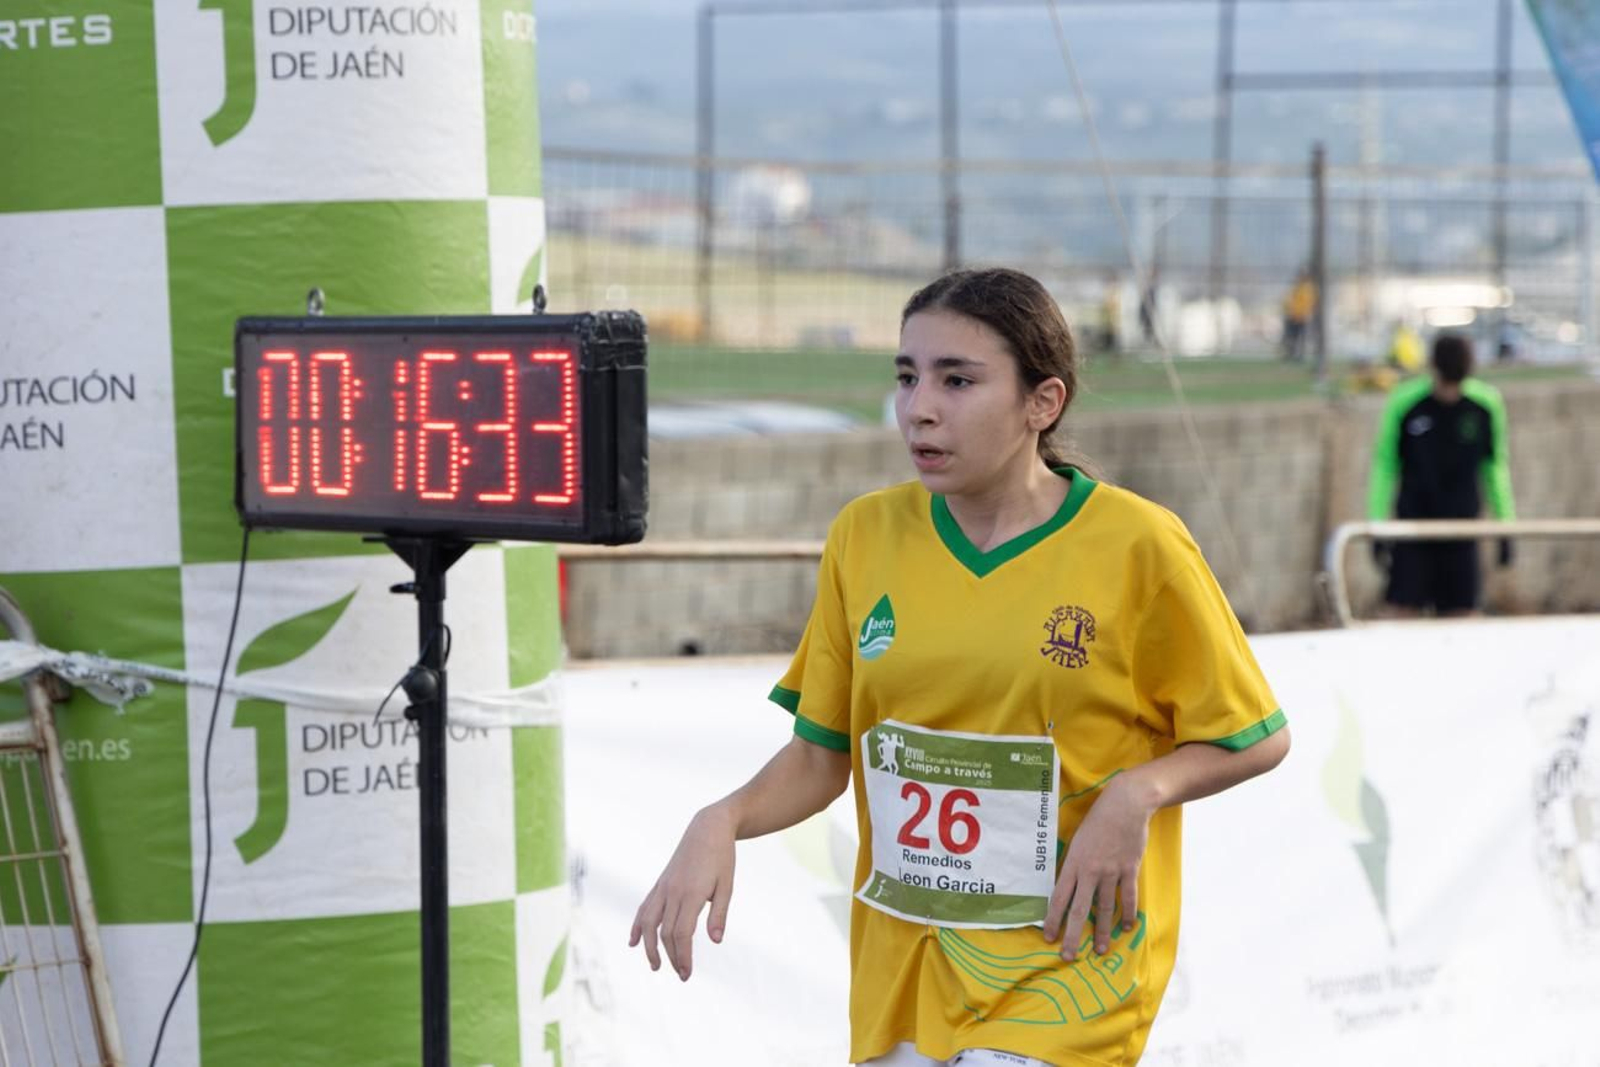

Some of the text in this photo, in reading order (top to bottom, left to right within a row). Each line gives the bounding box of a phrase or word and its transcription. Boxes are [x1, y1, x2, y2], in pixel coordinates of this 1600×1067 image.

[269, 3, 457, 36] DIPUTACIÓN
[271, 45, 404, 80] DE JAÉN
[860, 616, 894, 643] Jaén
[303, 757, 420, 797] DE JAÉ
[904, 758, 993, 779] Campo a través
[897, 781, 981, 856] 26
[1035, 769, 1050, 872] SUB16 Femenino
[902, 848, 972, 871] Remedios
[936, 875, 996, 895] Garcia
